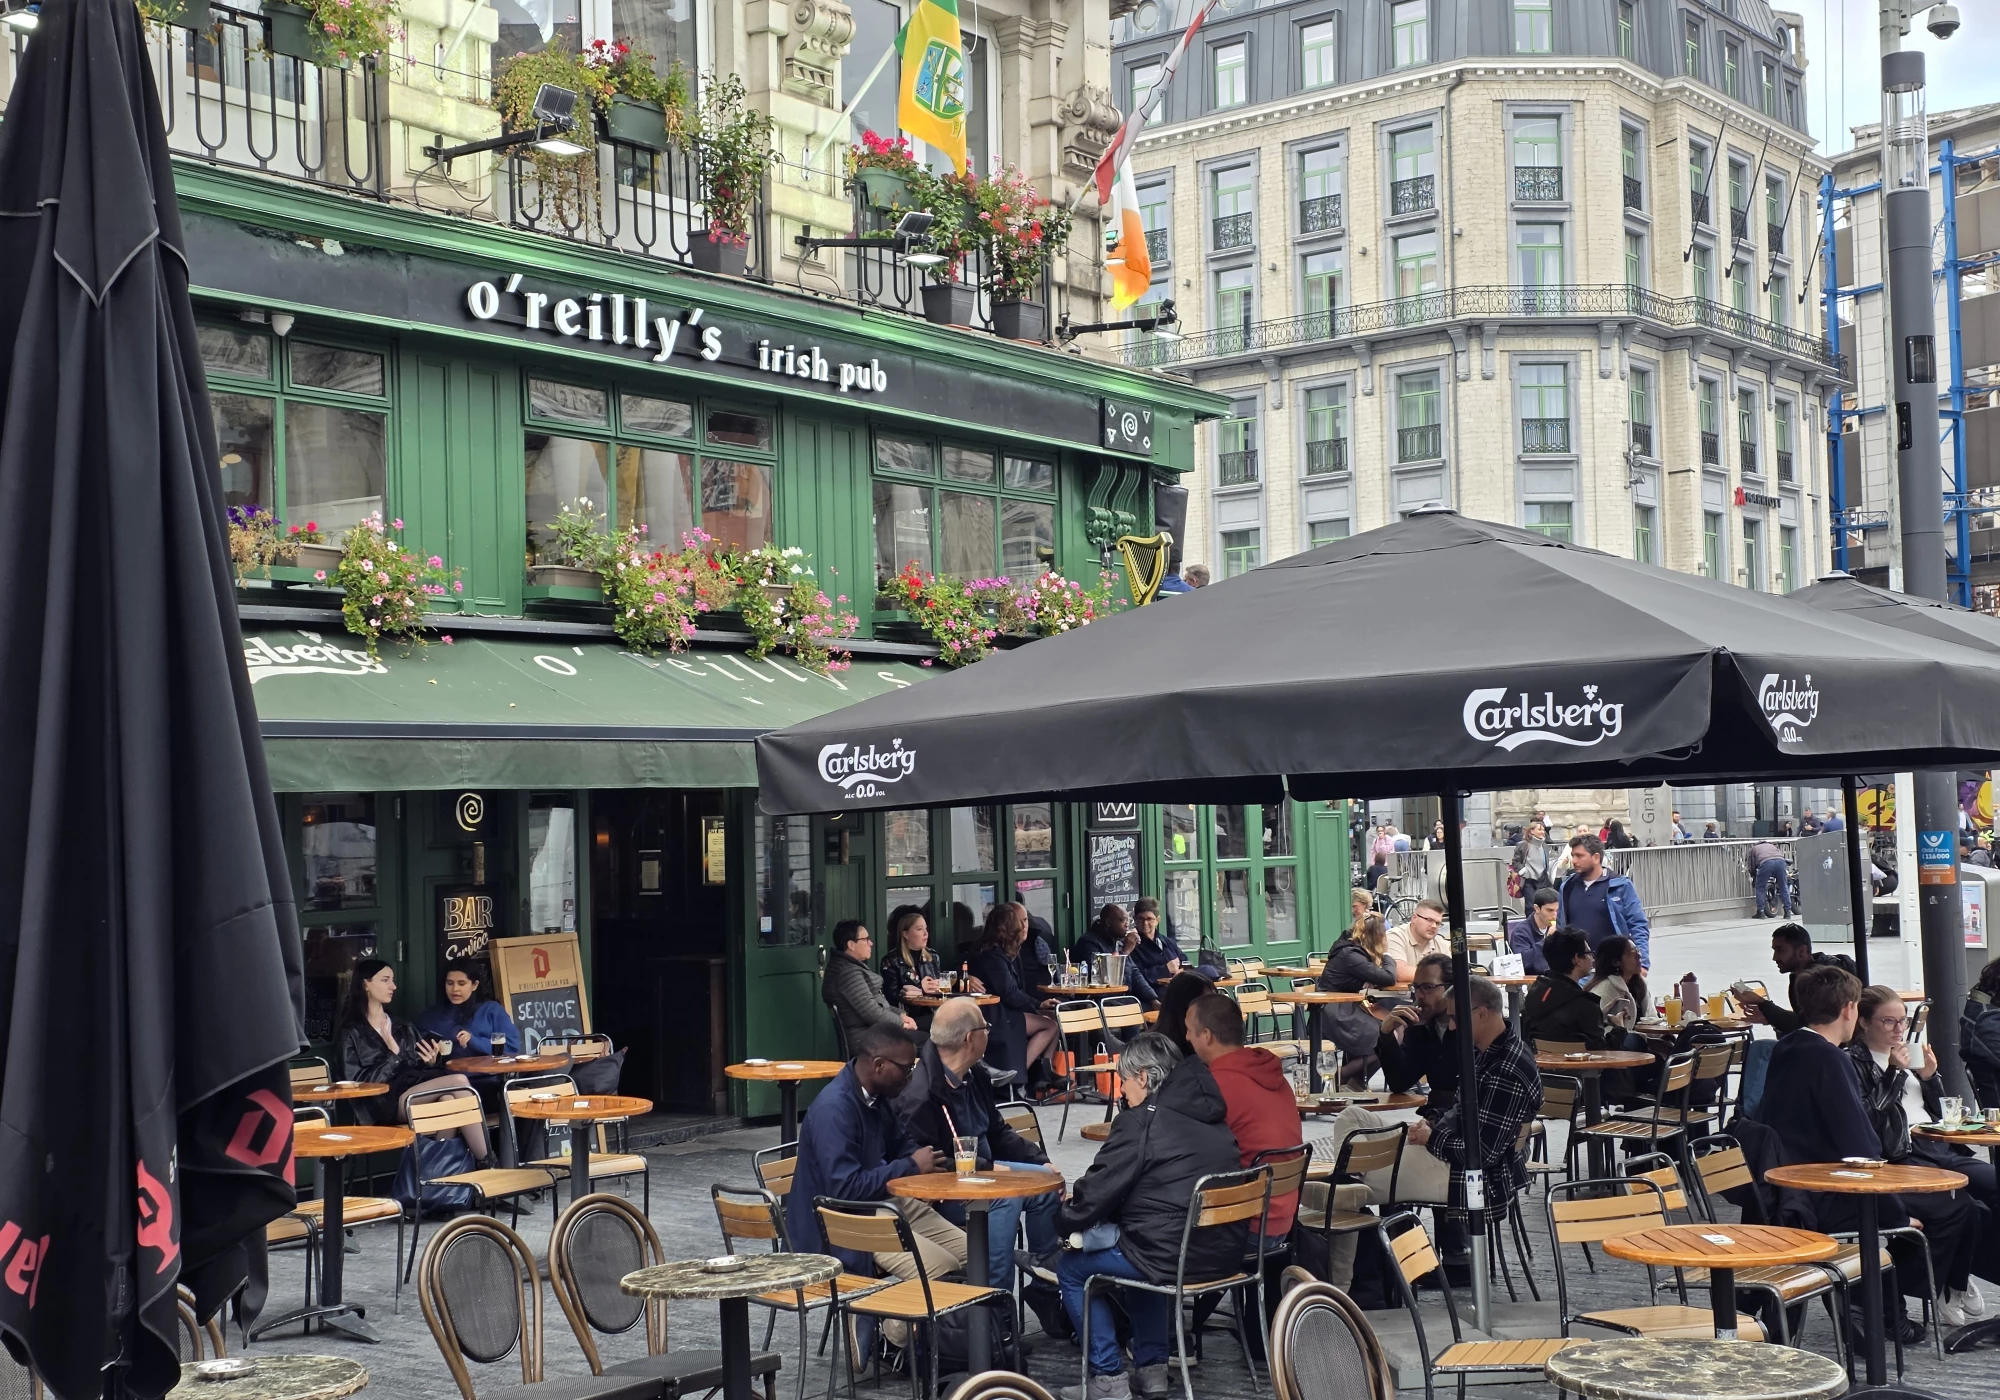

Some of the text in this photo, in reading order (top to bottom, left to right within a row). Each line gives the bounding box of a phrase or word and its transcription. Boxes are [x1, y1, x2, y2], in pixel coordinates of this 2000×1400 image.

[467, 272, 723, 363] o'reilly's
[758, 339, 887, 393] irish pub
[244, 636, 388, 675] sberg
[1462, 686, 1624, 743] Carlsberg
[1759, 673, 1820, 722] Carlsberg
[817, 741, 917, 784] Carlsberg
[855, 783, 876, 799] 0.0
[1641, 787, 1655, 824] Gran
[443, 896, 493, 932] BAR
[518, 999, 576, 1021] SERVICE
